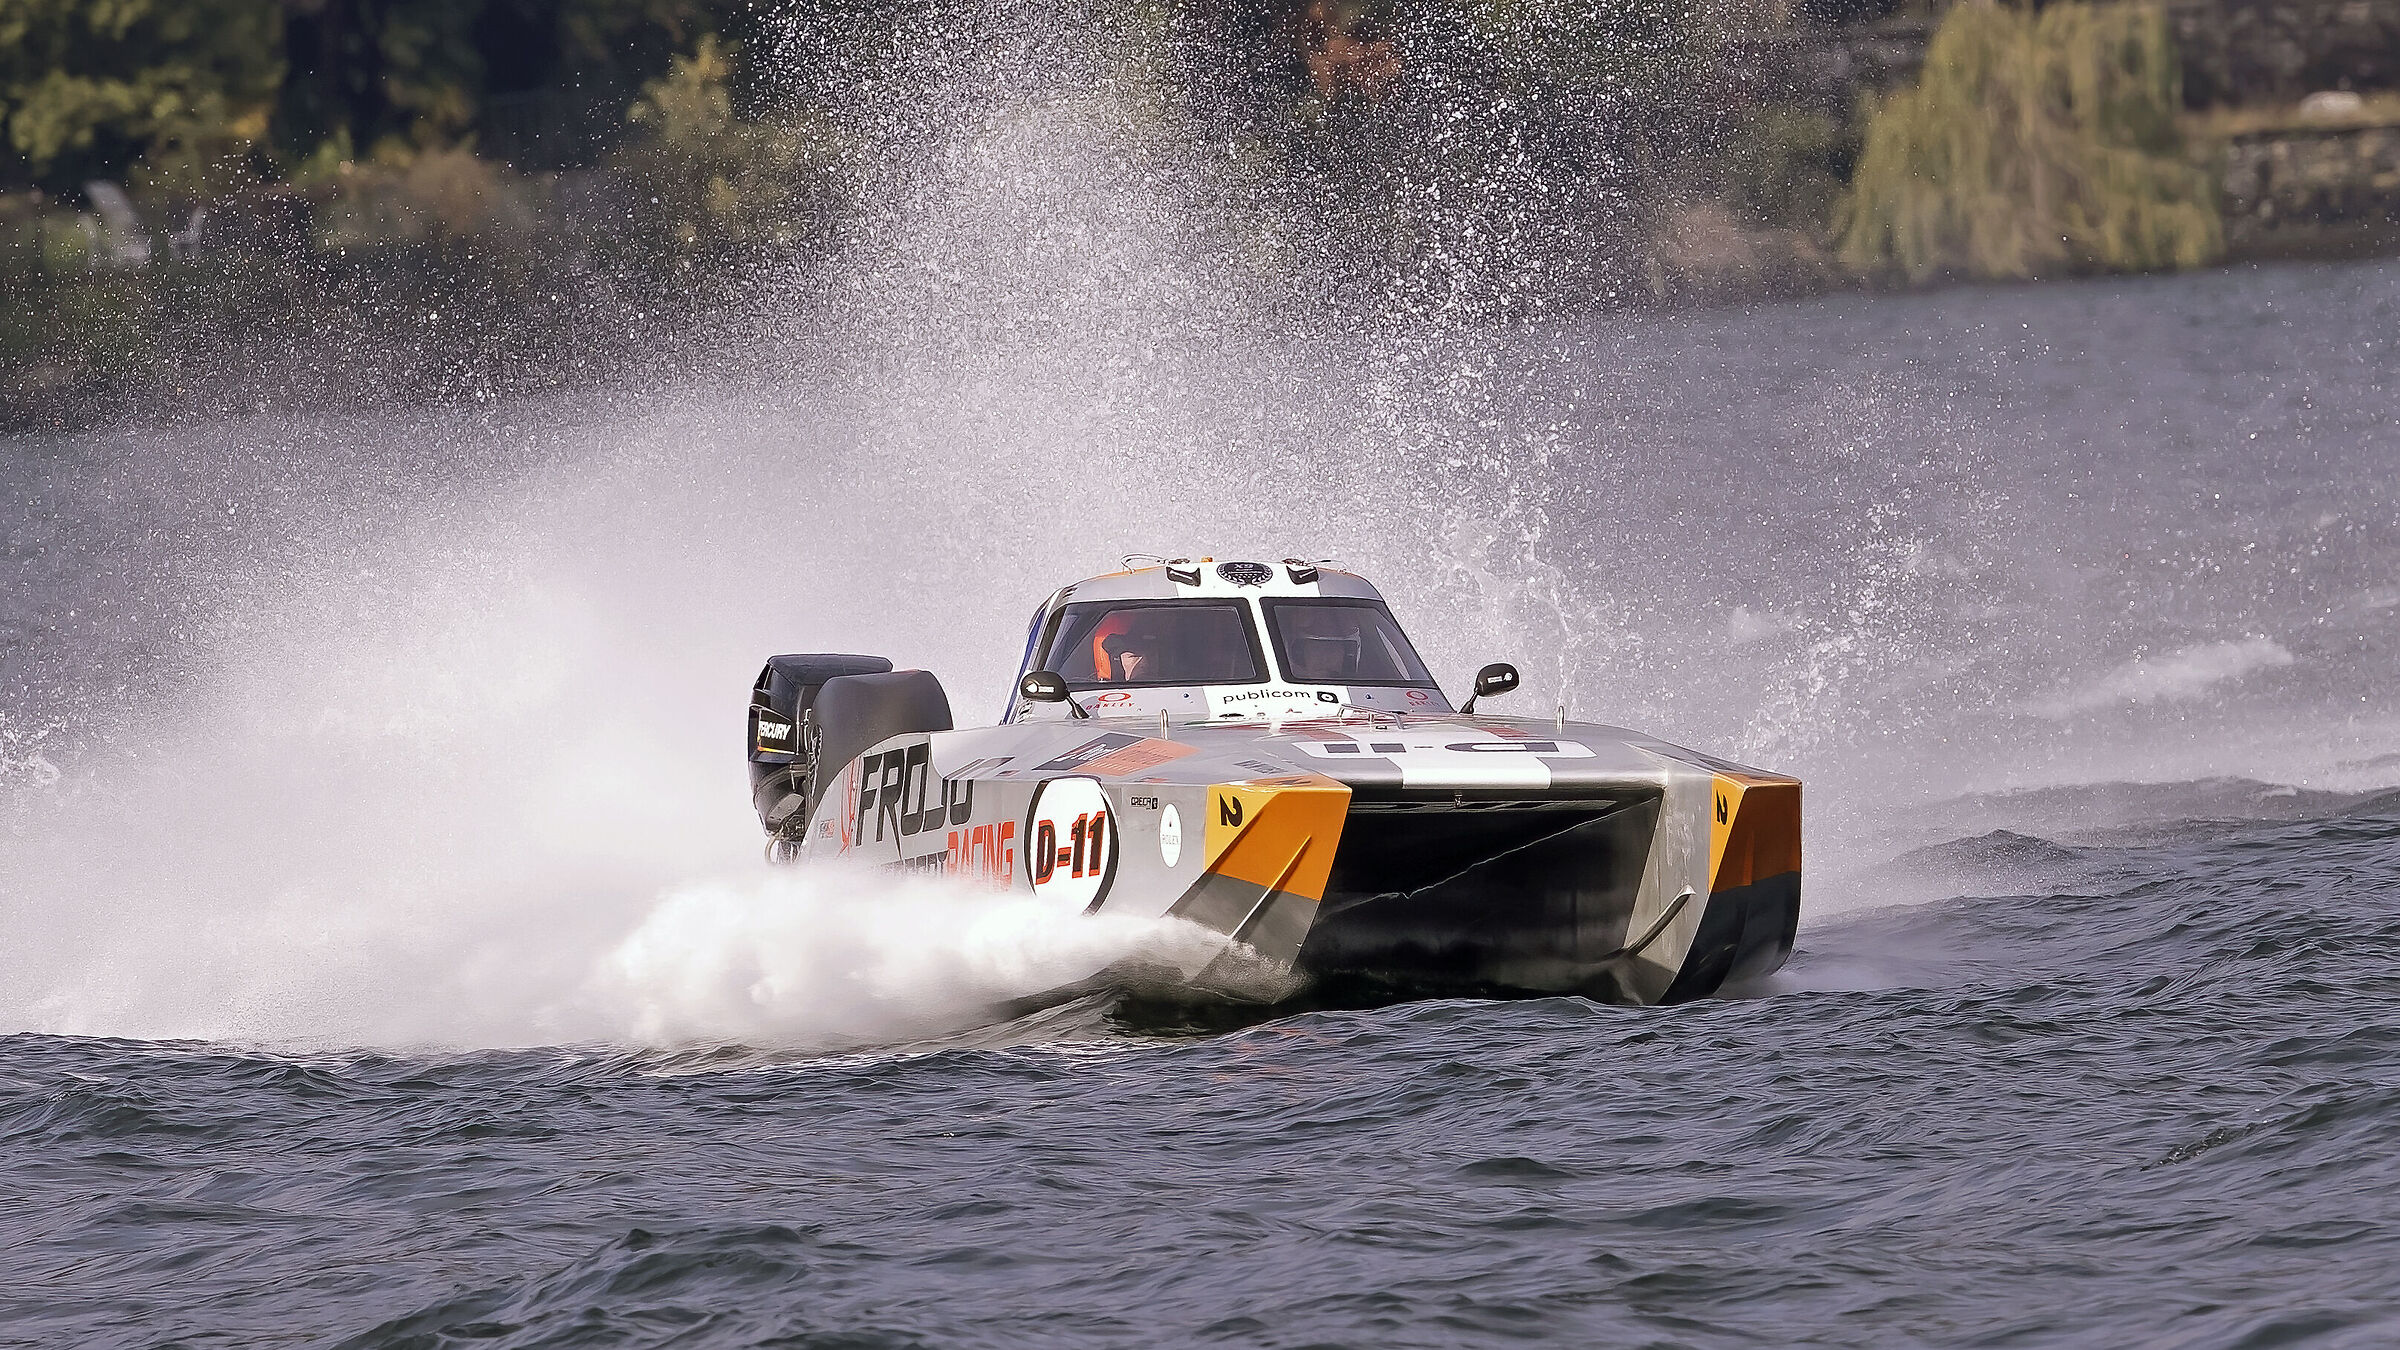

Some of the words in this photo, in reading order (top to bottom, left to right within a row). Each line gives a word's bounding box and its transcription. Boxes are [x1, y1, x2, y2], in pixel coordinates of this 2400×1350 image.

[1223, 689, 1311, 704] publicom
[759, 720, 792, 740] ERCURY
[1219, 792, 1243, 827] 2
[948, 821, 1015, 887] RACING
[1035, 811, 1107, 885] D-11
